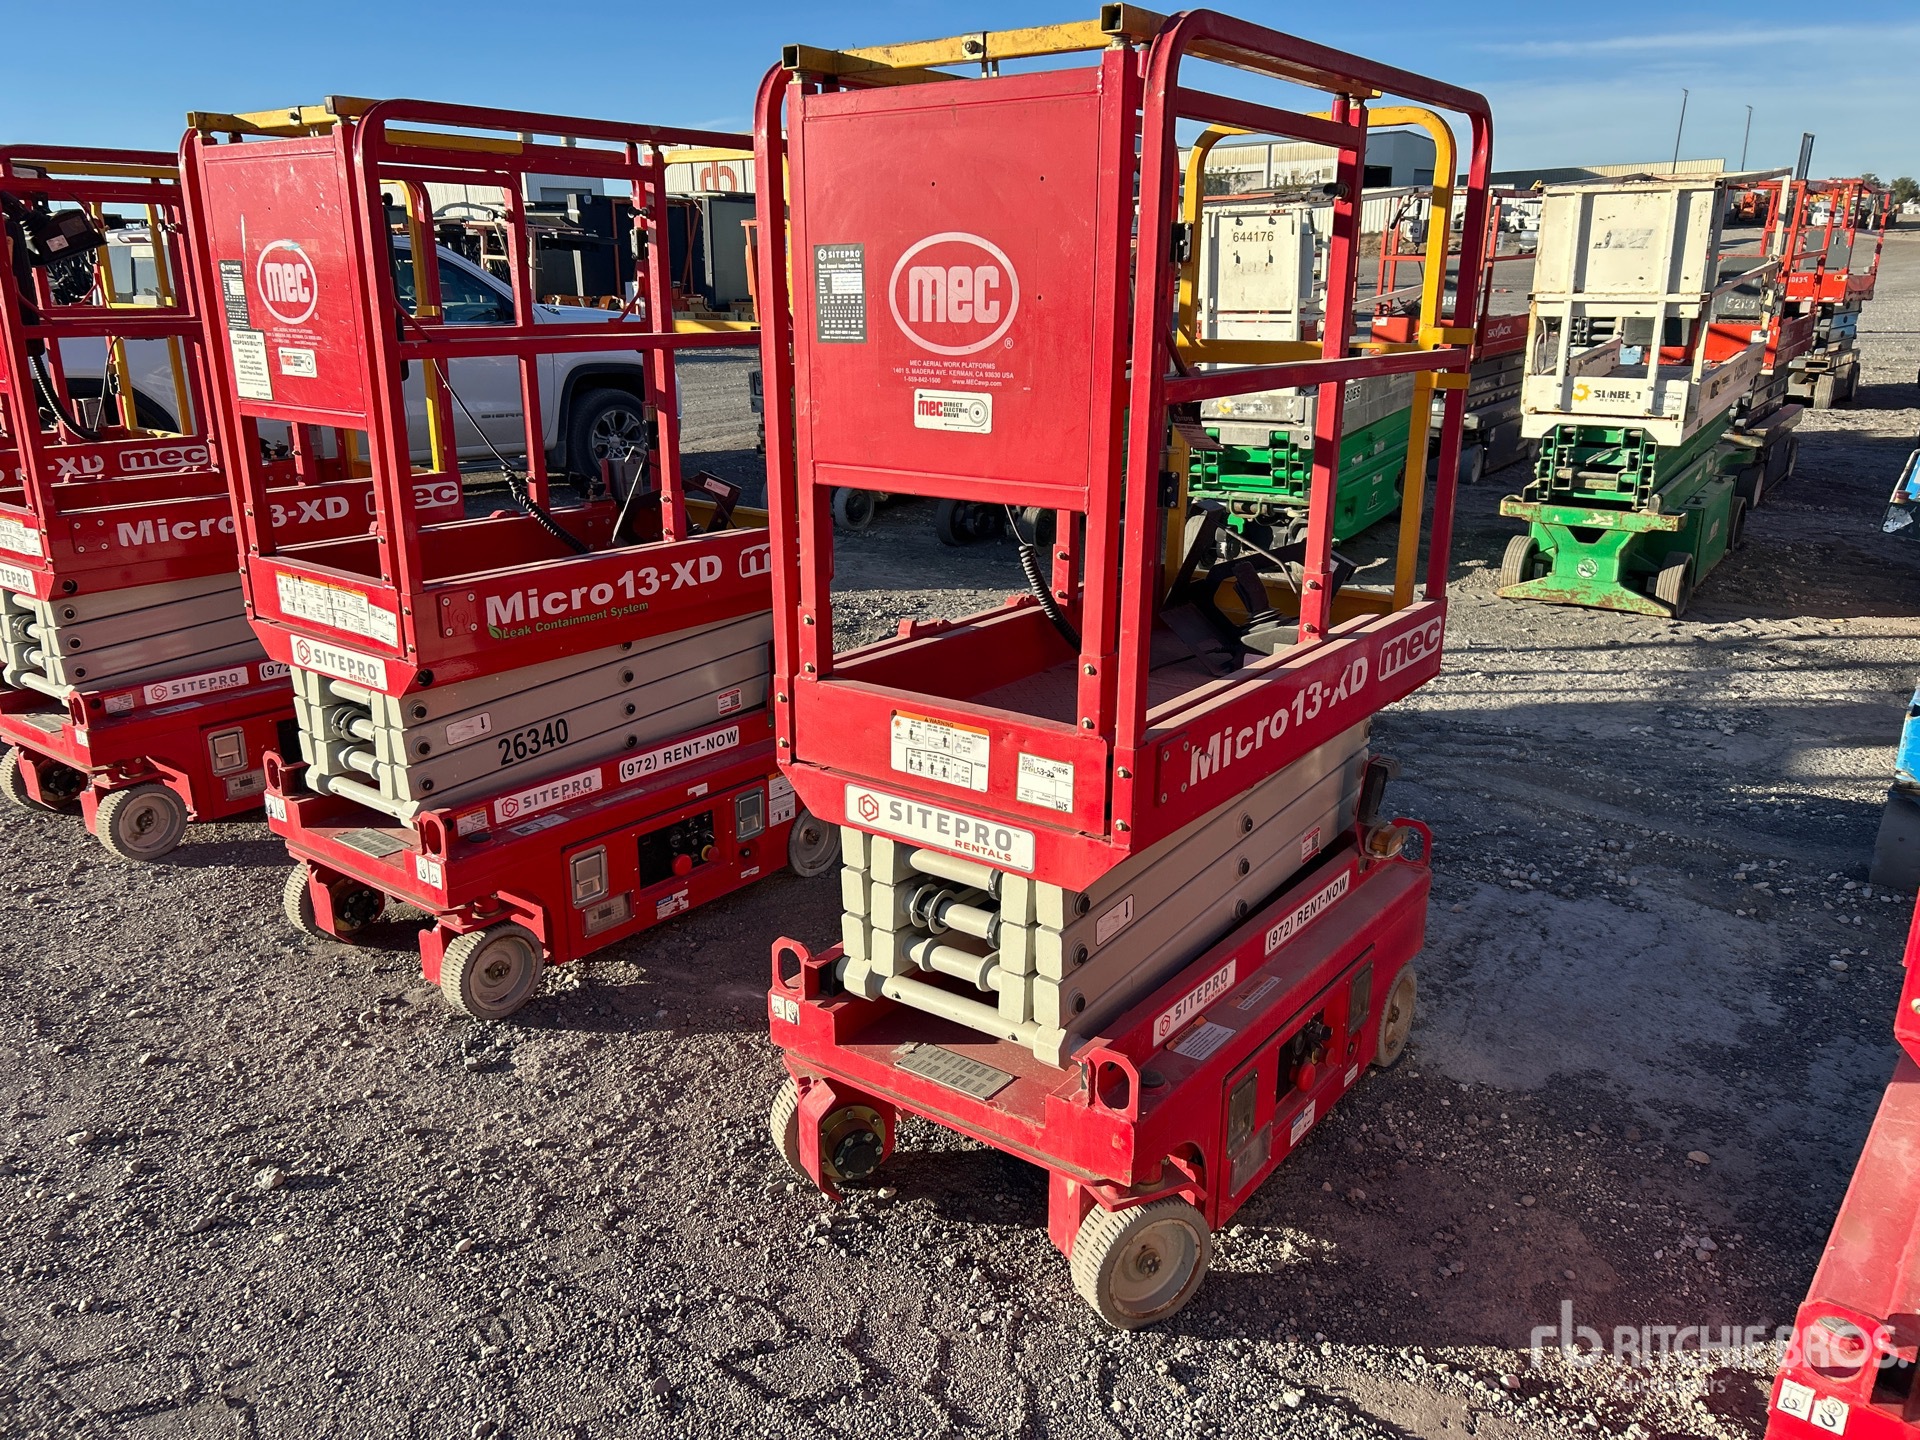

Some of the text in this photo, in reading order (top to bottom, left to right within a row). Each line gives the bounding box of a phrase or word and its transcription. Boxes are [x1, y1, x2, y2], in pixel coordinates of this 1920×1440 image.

[1232, 231, 1274, 242] 644176
[264, 262, 310, 303] mec
[909, 266, 999, 323] mec
[1345, 386, 1360, 402] 30ES
[1593, 389, 1641, 400] SUNBET
[918, 400, 943, 416] mec
[121, 448, 208, 469] mec
[414, 483, 458, 504] ec
[0, 568, 29, 588] TEPRO
[502, 601, 649, 639] Leak Containment System
[1379, 617, 1441, 680] mec
[261, 663, 291, 679] (972
[314, 648, 377, 681] SITEPRO
[172, 672, 239, 695] SITEPRO
[210, 681, 239, 691] RENTALS
[349, 673, 378, 687] RENTALS
[929, 717, 954, 728] WARNING
[497, 717, 569, 766] 26340
[620, 730, 739, 779] (972) RENT-NOW
[523, 775, 593, 809] SITEPRO
[562, 787, 593, 801] RENTALS
[889, 800, 1012, 851] SITEPRO
[955, 839, 1012, 862] RENTALS
[1268, 875, 1347, 951] (972) RENT-NOW
[1175, 967, 1228, 1021] SITEPRO
[1203, 983, 1227, 1004] RENTALS
